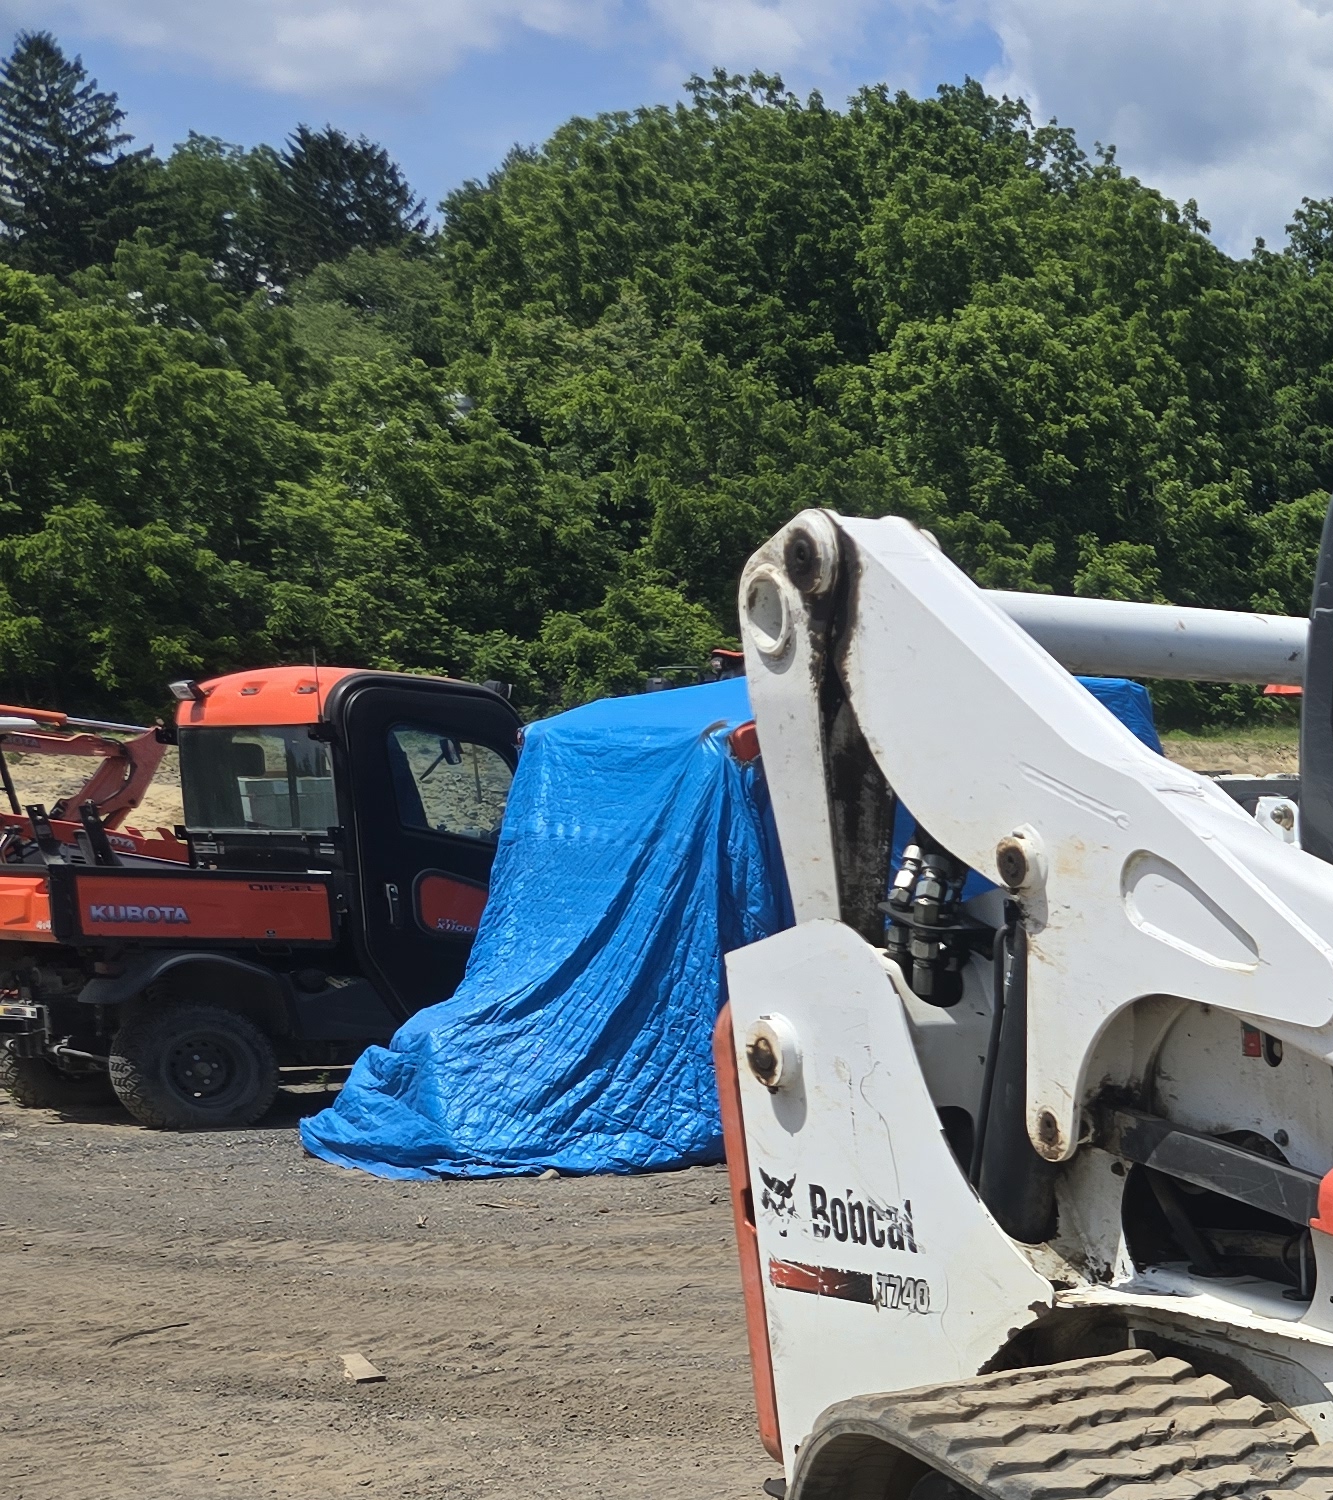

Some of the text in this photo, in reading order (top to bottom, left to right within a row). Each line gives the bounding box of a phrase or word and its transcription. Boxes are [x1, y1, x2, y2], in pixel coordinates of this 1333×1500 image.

[106, 835, 135, 849] OTA
[248, 883, 321, 892] DIESEL
[89, 905, 190, 923] KUBOTA
[808, 1183, 918, 1253] Bobcat
[876, 1272, 931, 1315] T740
